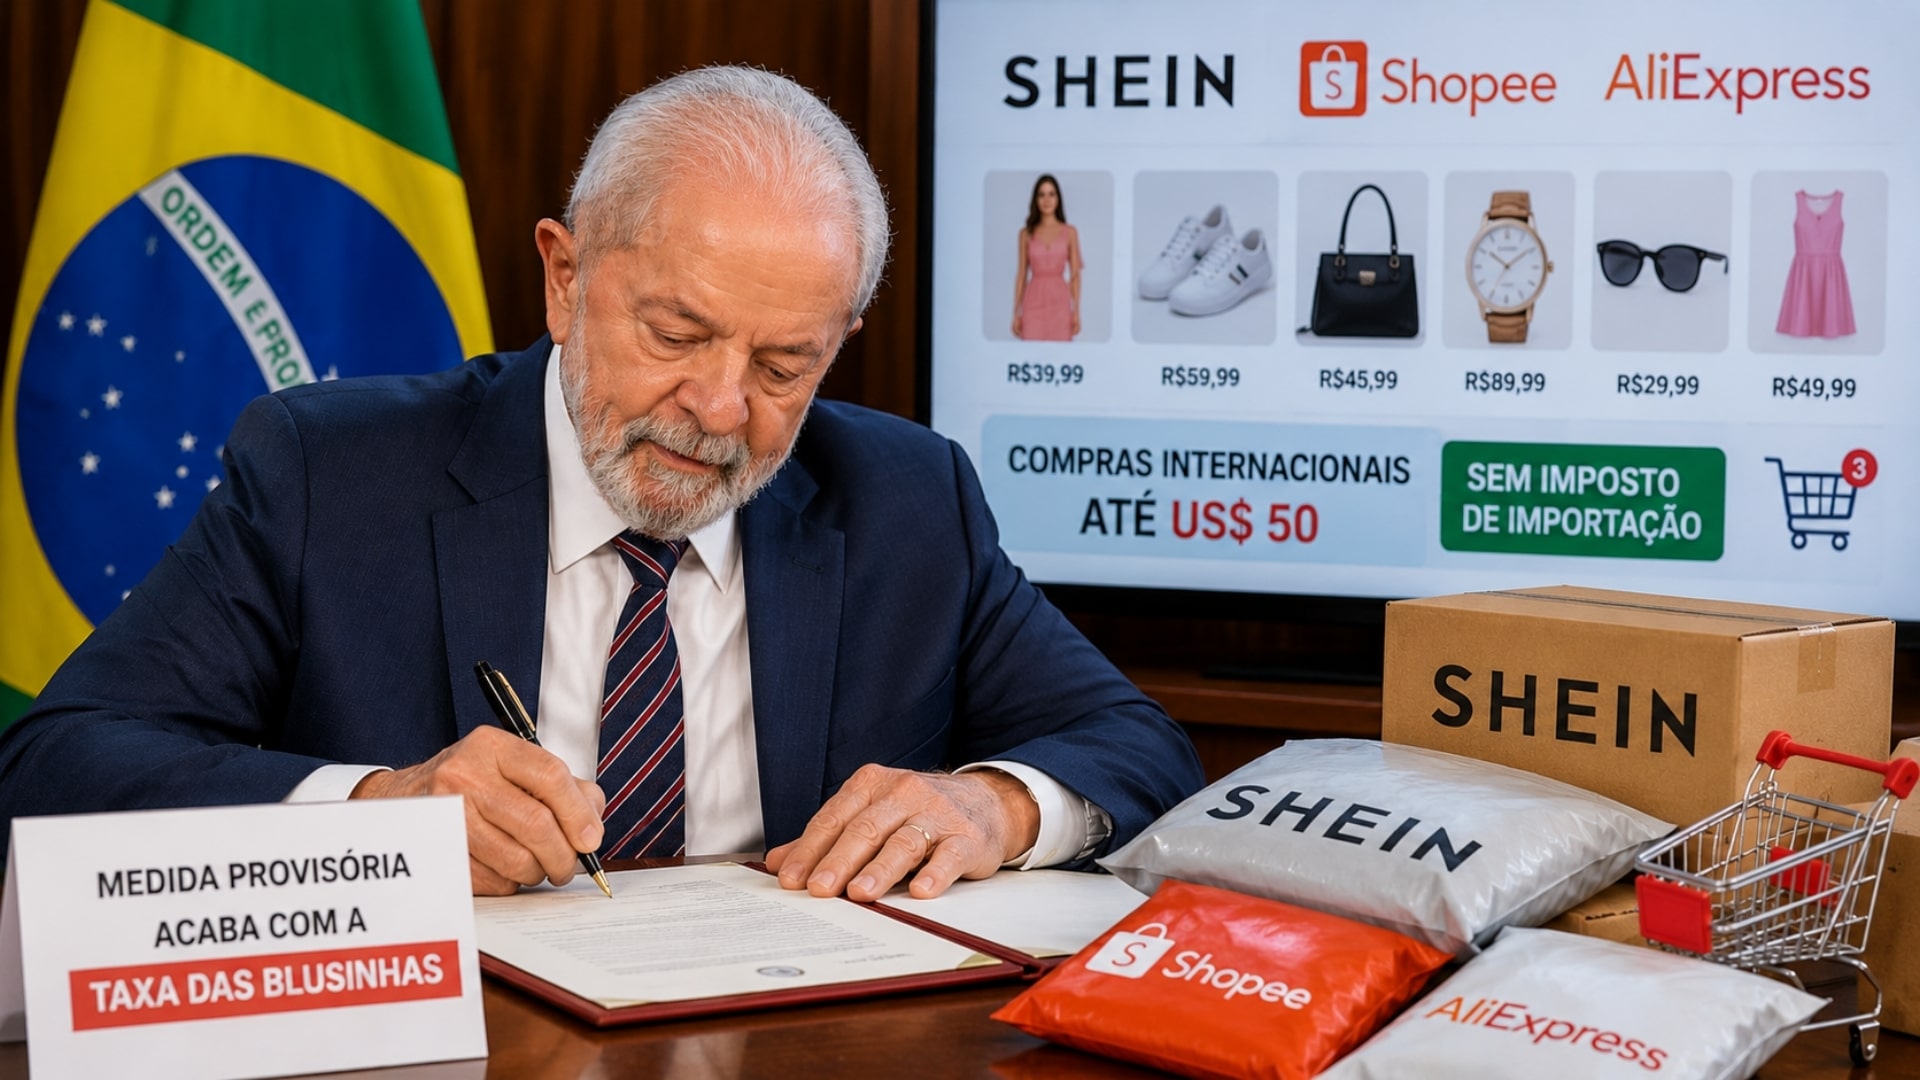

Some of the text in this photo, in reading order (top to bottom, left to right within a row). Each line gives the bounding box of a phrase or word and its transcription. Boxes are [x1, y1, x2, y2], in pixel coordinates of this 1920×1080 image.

[1003, 54, 1235, 108] SHEIN
[1324, 57, 1558, 117] S Shopee
[1604, 52, 1871, 115] AliExpress
[161, 185, 306, 387] ORDEM E PRO
[1007, 363, 1085, 386] R$39,99
[1161, 366, 1241, 390] R$59,99
[1319, 369, 1399, 390] R$45,99
[1464, 371, 1547, 394] R$89,99
[1616, 374, 1700, 398] R$29,99
[1772, 376, 1857, 401] R$49,99
[1008, 444, 1411, 485] COMPRAS INTERNACIONAIS
[1466, 462, 1681, 498] SEM IMPOSTO
[1851, 456, 1868, 481] 3
[1079, 490, 1319, 546] ATÉ US$ 50
[1462, 503, 1702, 546] DE IMPORTAÇÃO
[1431, 664, 1698, 758] SHEIN
[1205, 785, 1483, 873] SHEIN
[96, 849, 412, 899] MEDIDA PROVISÓRIA
[154, 906, 367, 948] ACABA COM A
[89, 953, 444, 1013] TAXA DAS BLUSINHAS
[1162, 950, 1312, 1010] Shopee
[1424, 996, 1669, 1071] AliExpress
